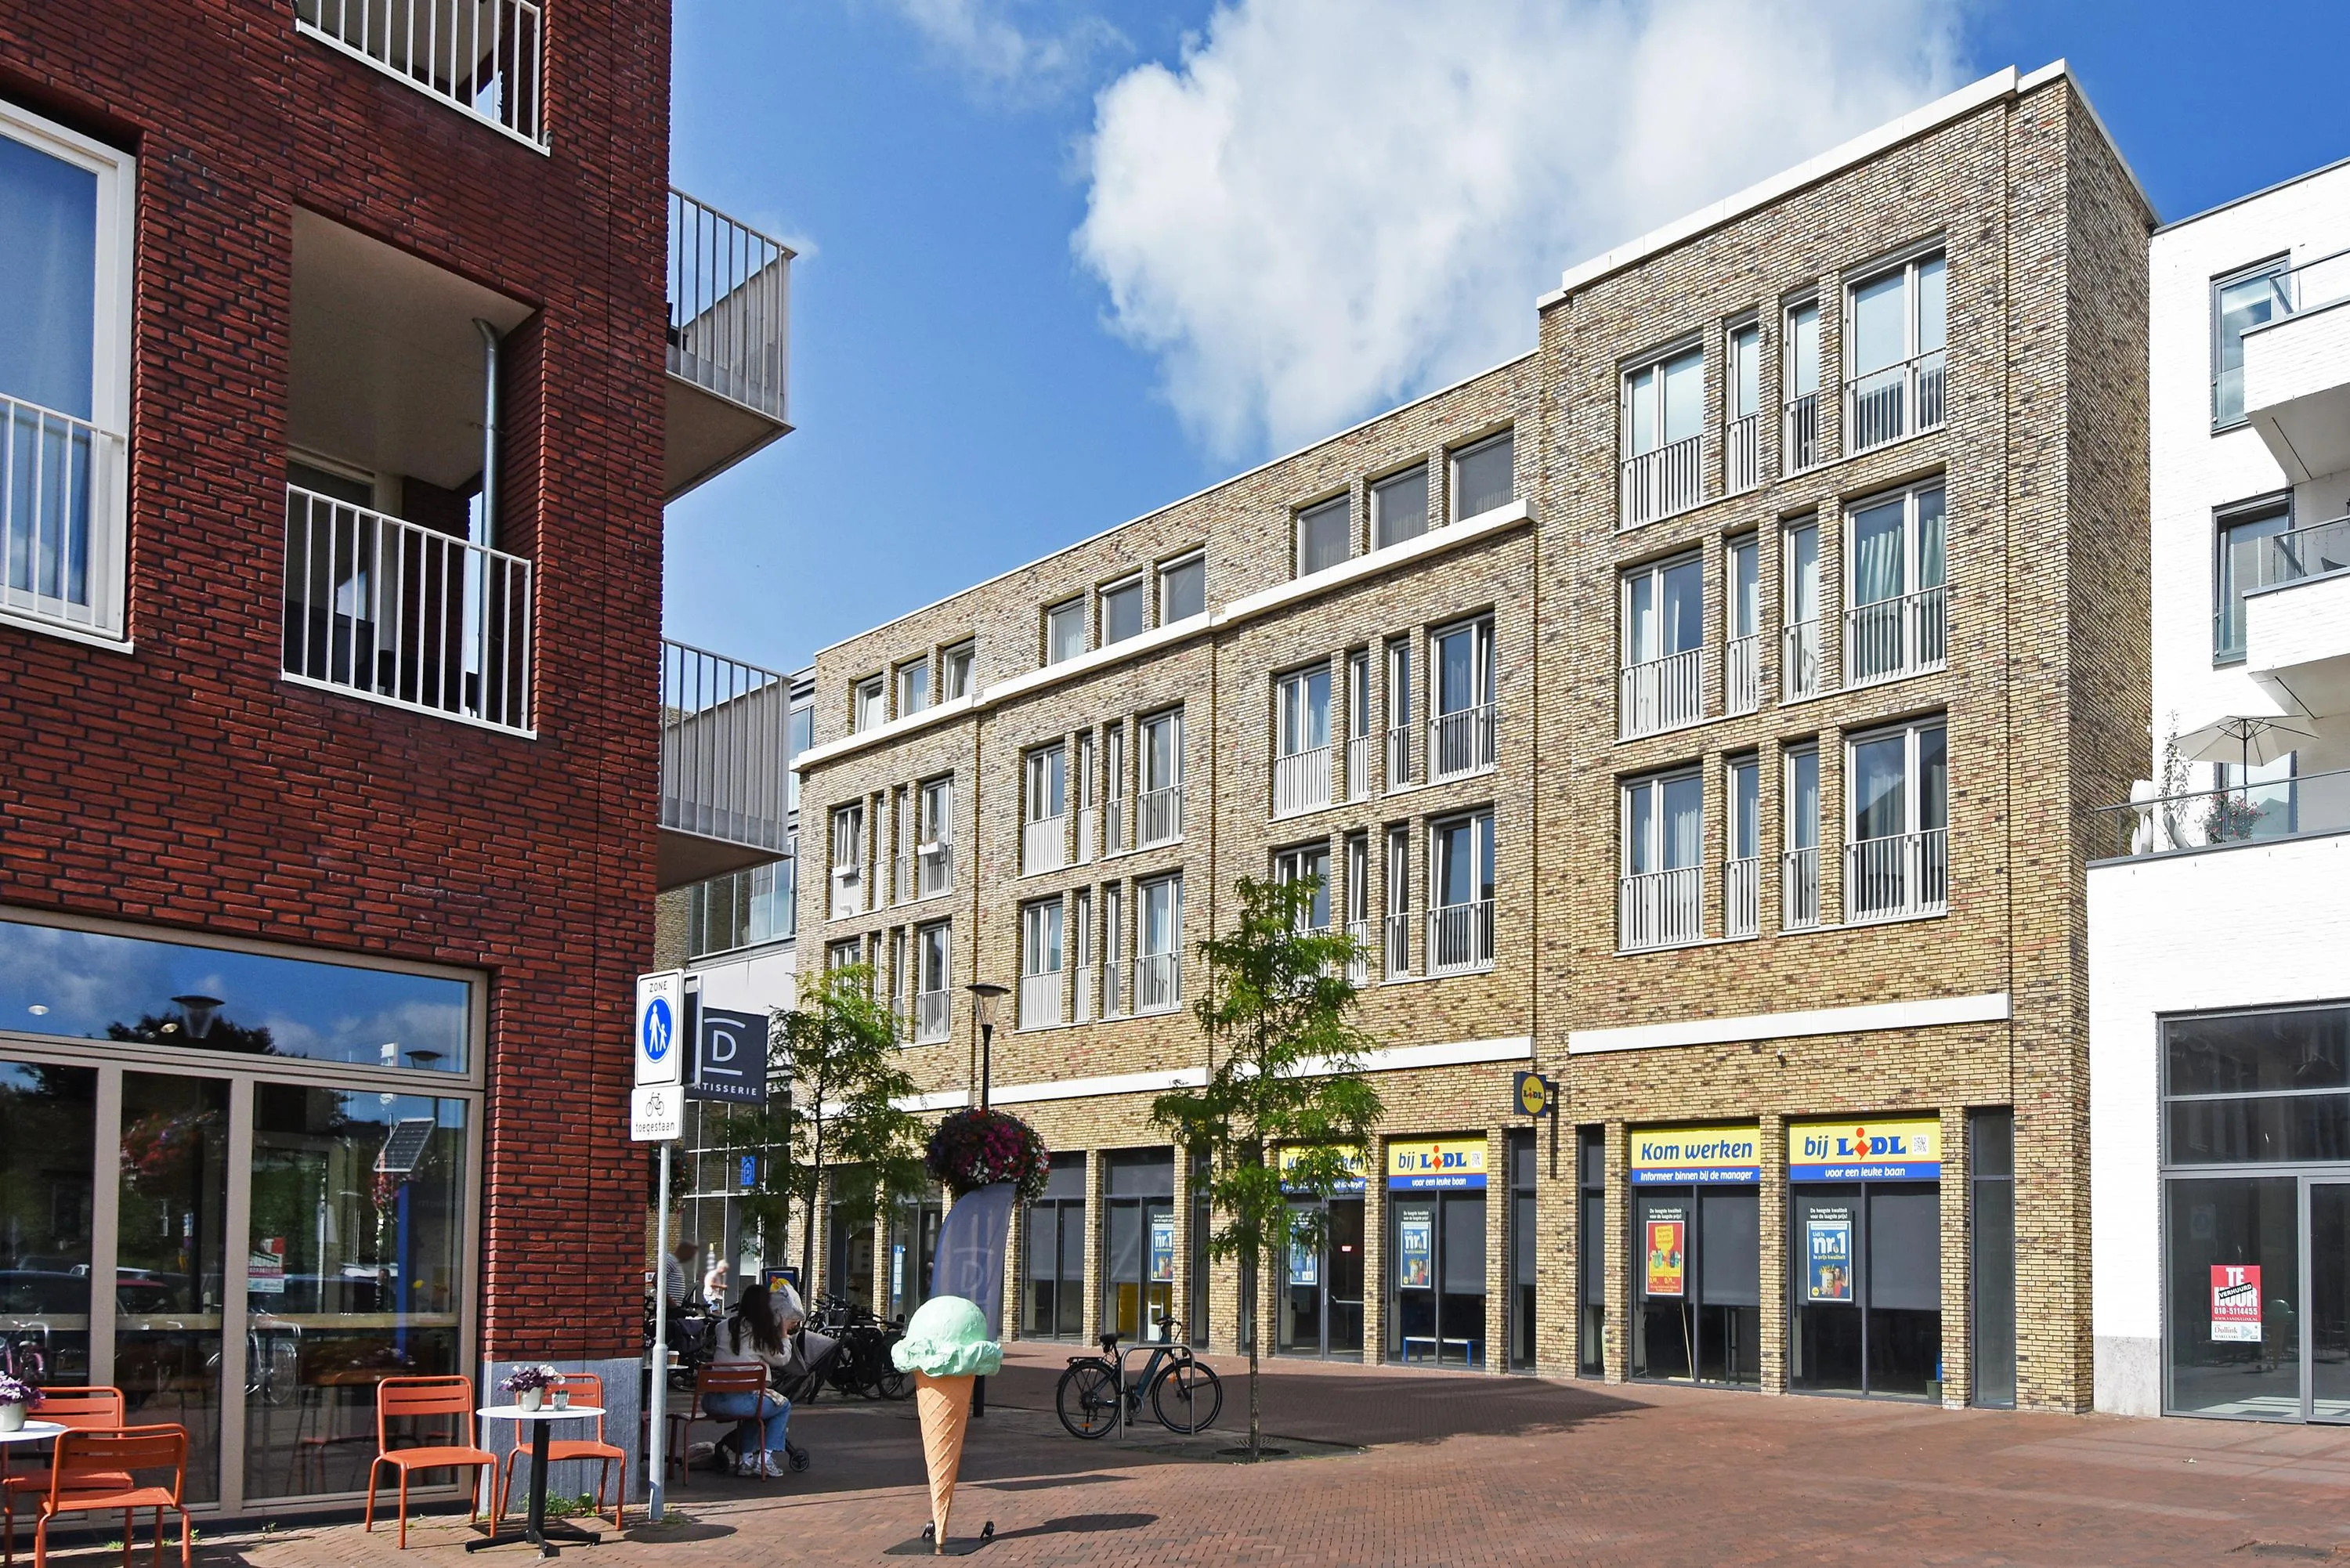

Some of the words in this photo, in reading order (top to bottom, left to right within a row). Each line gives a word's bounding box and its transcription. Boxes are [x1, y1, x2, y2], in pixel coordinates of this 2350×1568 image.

[649, 981, 667, 992] ZONE
[712, 1029, 737, 1062] D
[694, 1082, 757, 1096] ATISSERIE
[635, 1120, 675, 1135] toegestaan
[1641, 1143, 1679, 1160] Kom
[1685, 1140, 1753, 1159] werken
[1804, 1135, 1829, 1159] bij
[1398, 1151, 1415, 1171] bij
[1640, 1172, 1674, 1181] Informeer
[1675, 1171, 1698, 1180] binnen
[1699, 1171, 1709, 1181] bij
[1710, 1171, 1719, 1180] de
[1720, 1171, 1753, 1181] manager
[1825, 1169, 1842, 1177] voor
[1845, 1168, 1859, 1177] een
[1861, 1166, 1882, 1176] leuke
[1884, 1166, 1906, 1176] baan
[1436, 1177, 1452, 1186] leuke
[1452, 1176, 1466, 1186] baan
[2225, 1266, 2244, 1287] TE
[2218, 1284, 2252, 1299] VERHUURD
